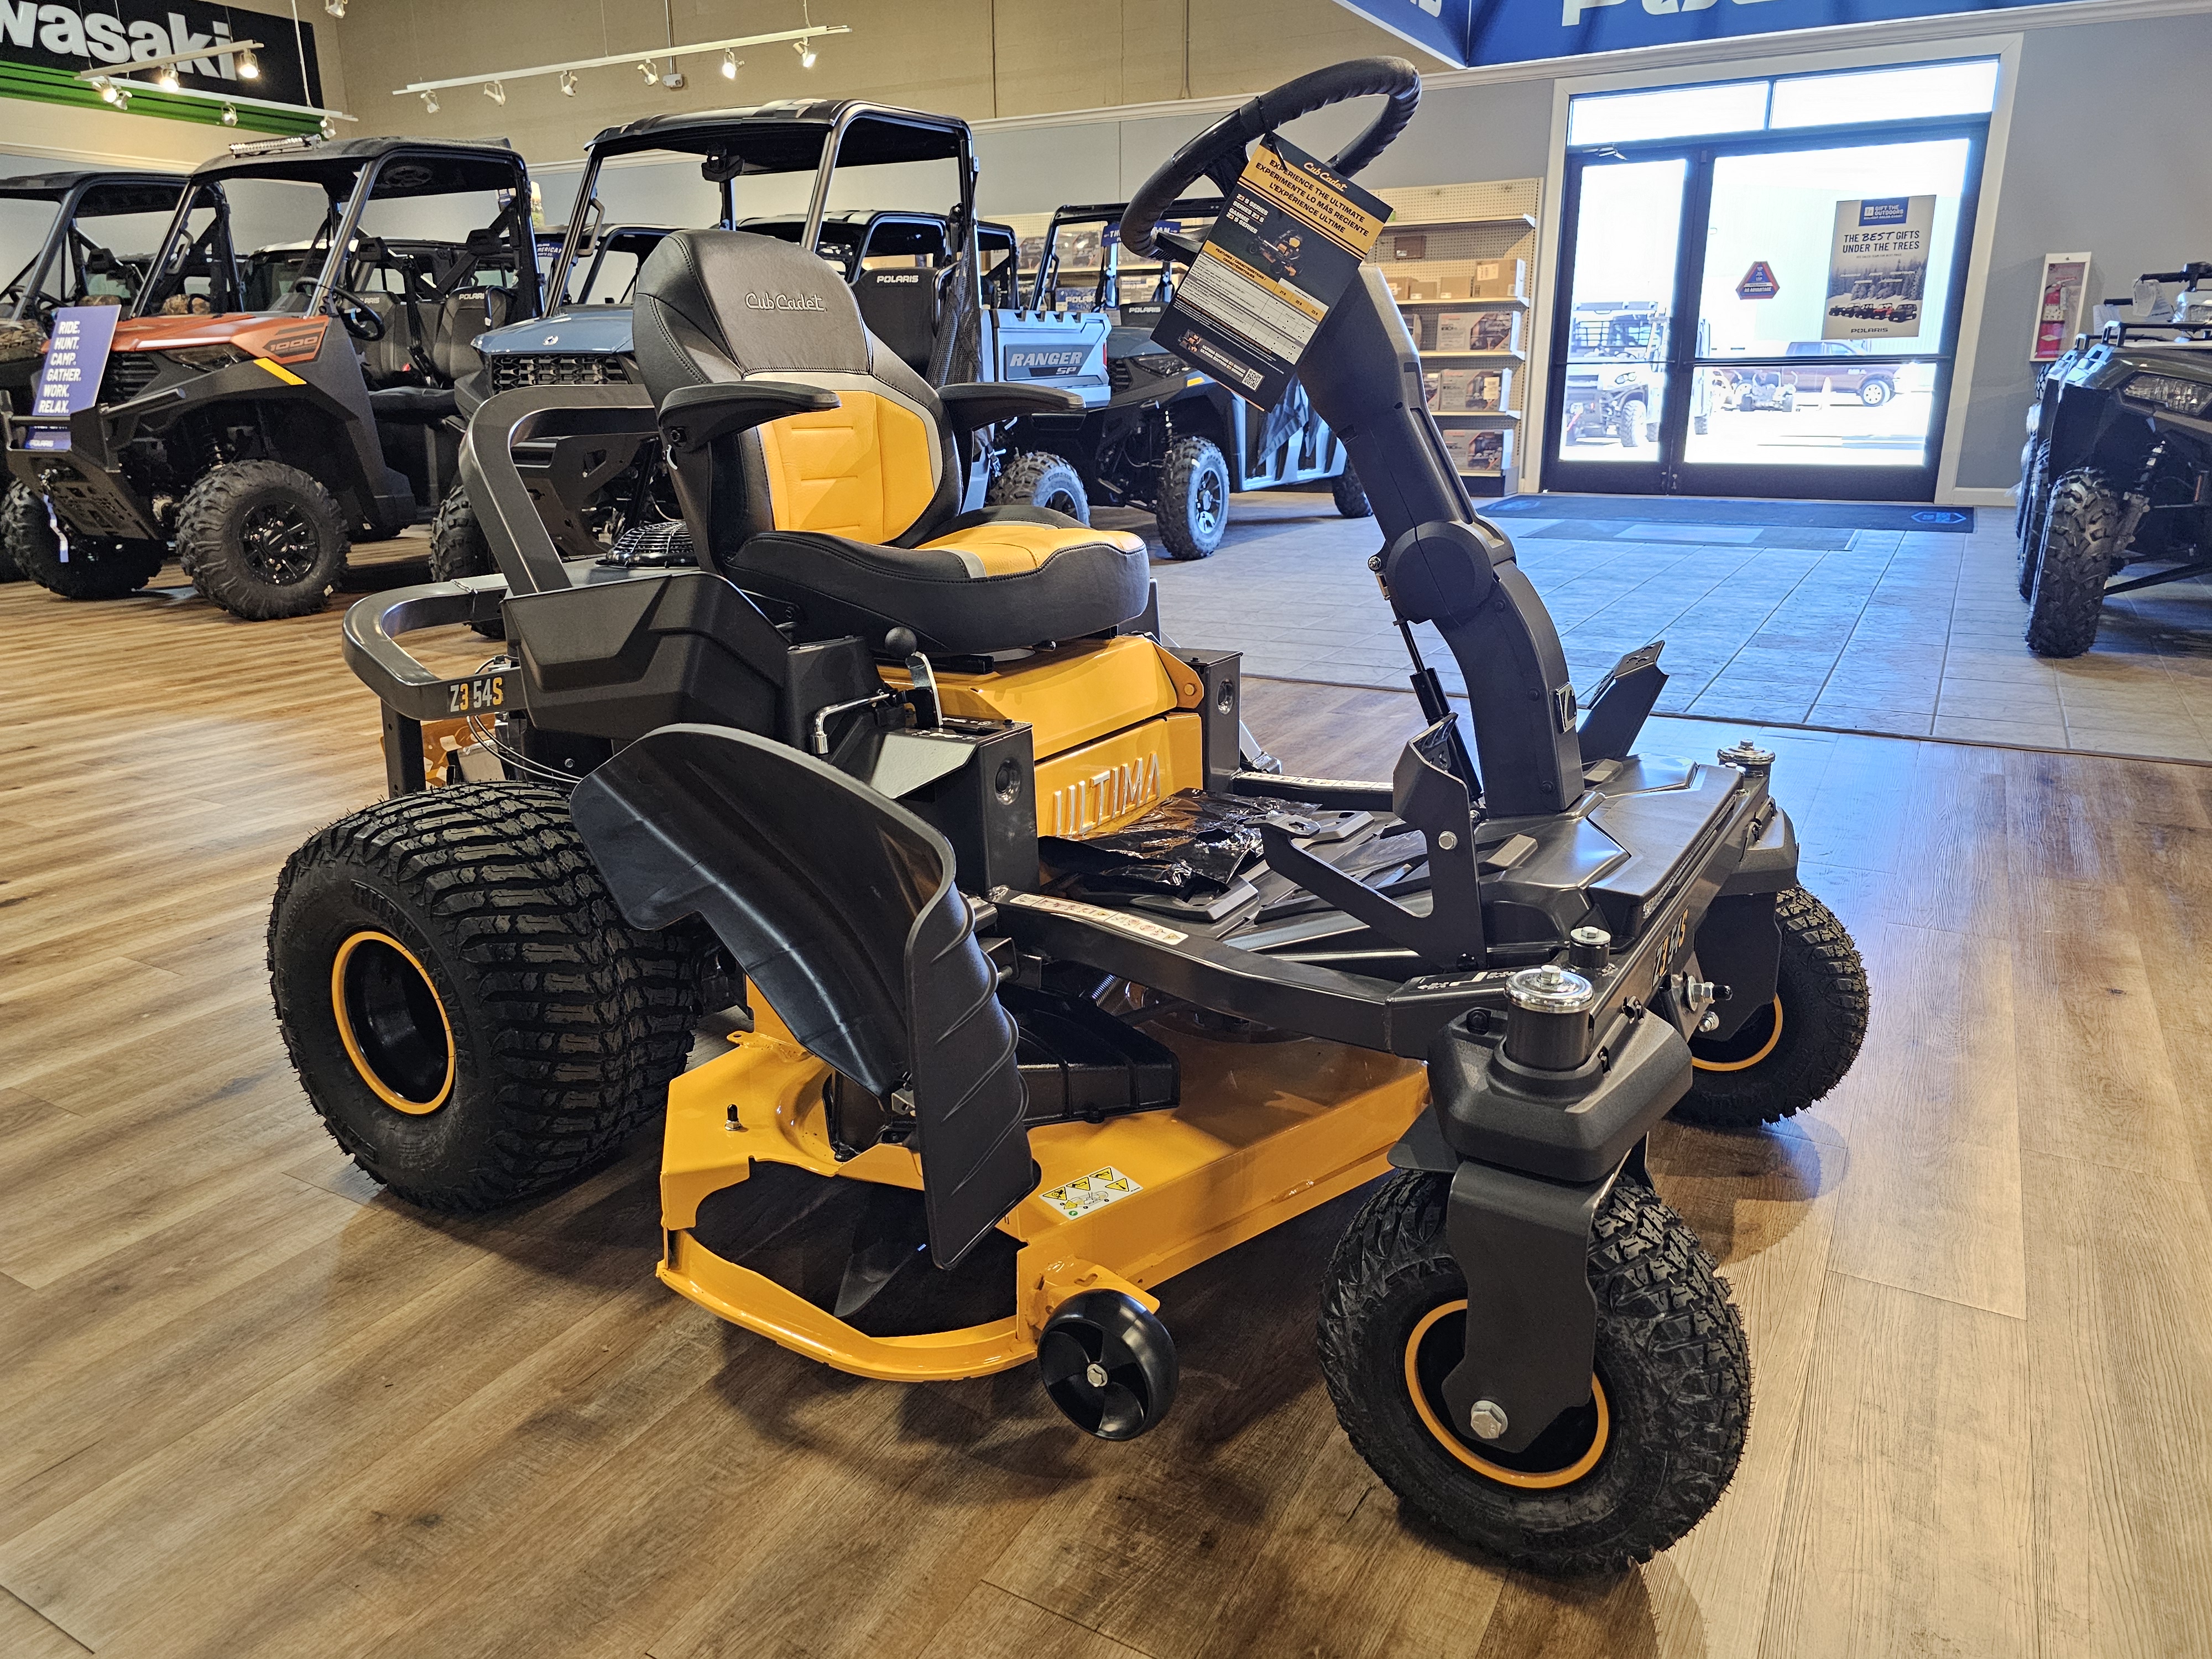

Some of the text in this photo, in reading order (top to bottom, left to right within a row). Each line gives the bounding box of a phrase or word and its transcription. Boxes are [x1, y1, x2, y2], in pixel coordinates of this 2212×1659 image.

[1303, 162, 1347, 192] Cub Cadet
[1269, 160, 1365, 223] EXPERIENCE THE ULTIMATE
[1255, 163, 1369, 237] EXPERIMENTE LO MÁS RECIENTE
[1229, 208, 1250, 223] GAMME
[1233, 201, 1252, 215] SERIES
[1249, 201, 1269, 216] SERIES
[1238, 220, 1258, 234] SERIES
[1318, 212, 1346, 233] ULTIME
[1844, 231, 1919, 242] THE BEST GIFTS
[1843, 241, 1919, 253] UNDER THE TREES
[744, 292, 825, 312] Cub Cadet
[58, 321, 80, 334] RIDE.
[54, 336, 79, 350] HUNT.
[270, 336, 319, 352] 1000
[50, 352, 76, 366] CAMP.
[1010, 352, 1083, 367] RANGER
[46, 368, 81, 382] GATHER.
[43, 384, 70, 398] WORK.
[38, 400, 69, 414] RELAX.
[450, 677, 503, 712] Z3 54S
[1053, 751, 1160, 838] ULTIMA
